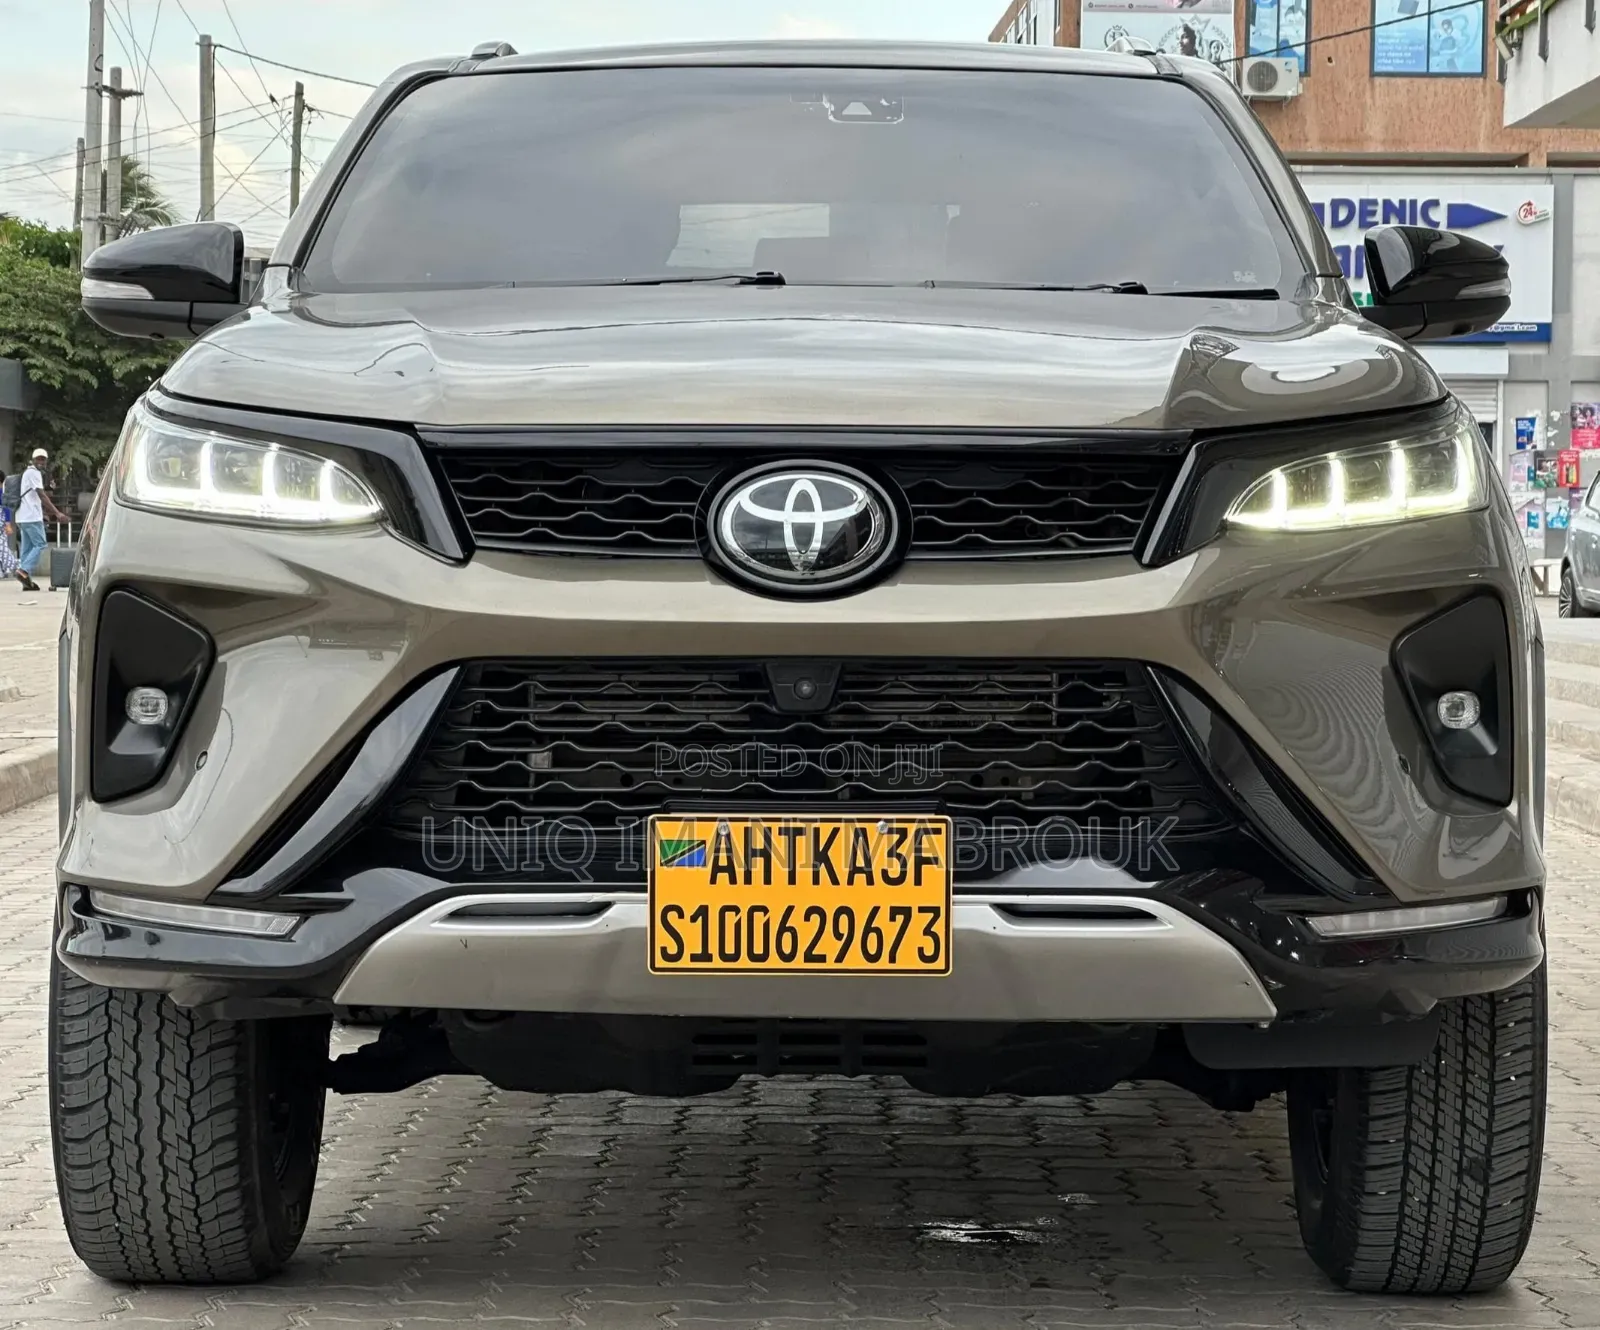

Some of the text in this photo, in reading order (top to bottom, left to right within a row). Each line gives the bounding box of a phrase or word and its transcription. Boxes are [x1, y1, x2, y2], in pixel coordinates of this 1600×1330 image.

[1330, 198, 1441, 229] DENIC
[709, 825, 943, 887] AHTKA3F
[659, 903, 942, 965] S100629673
